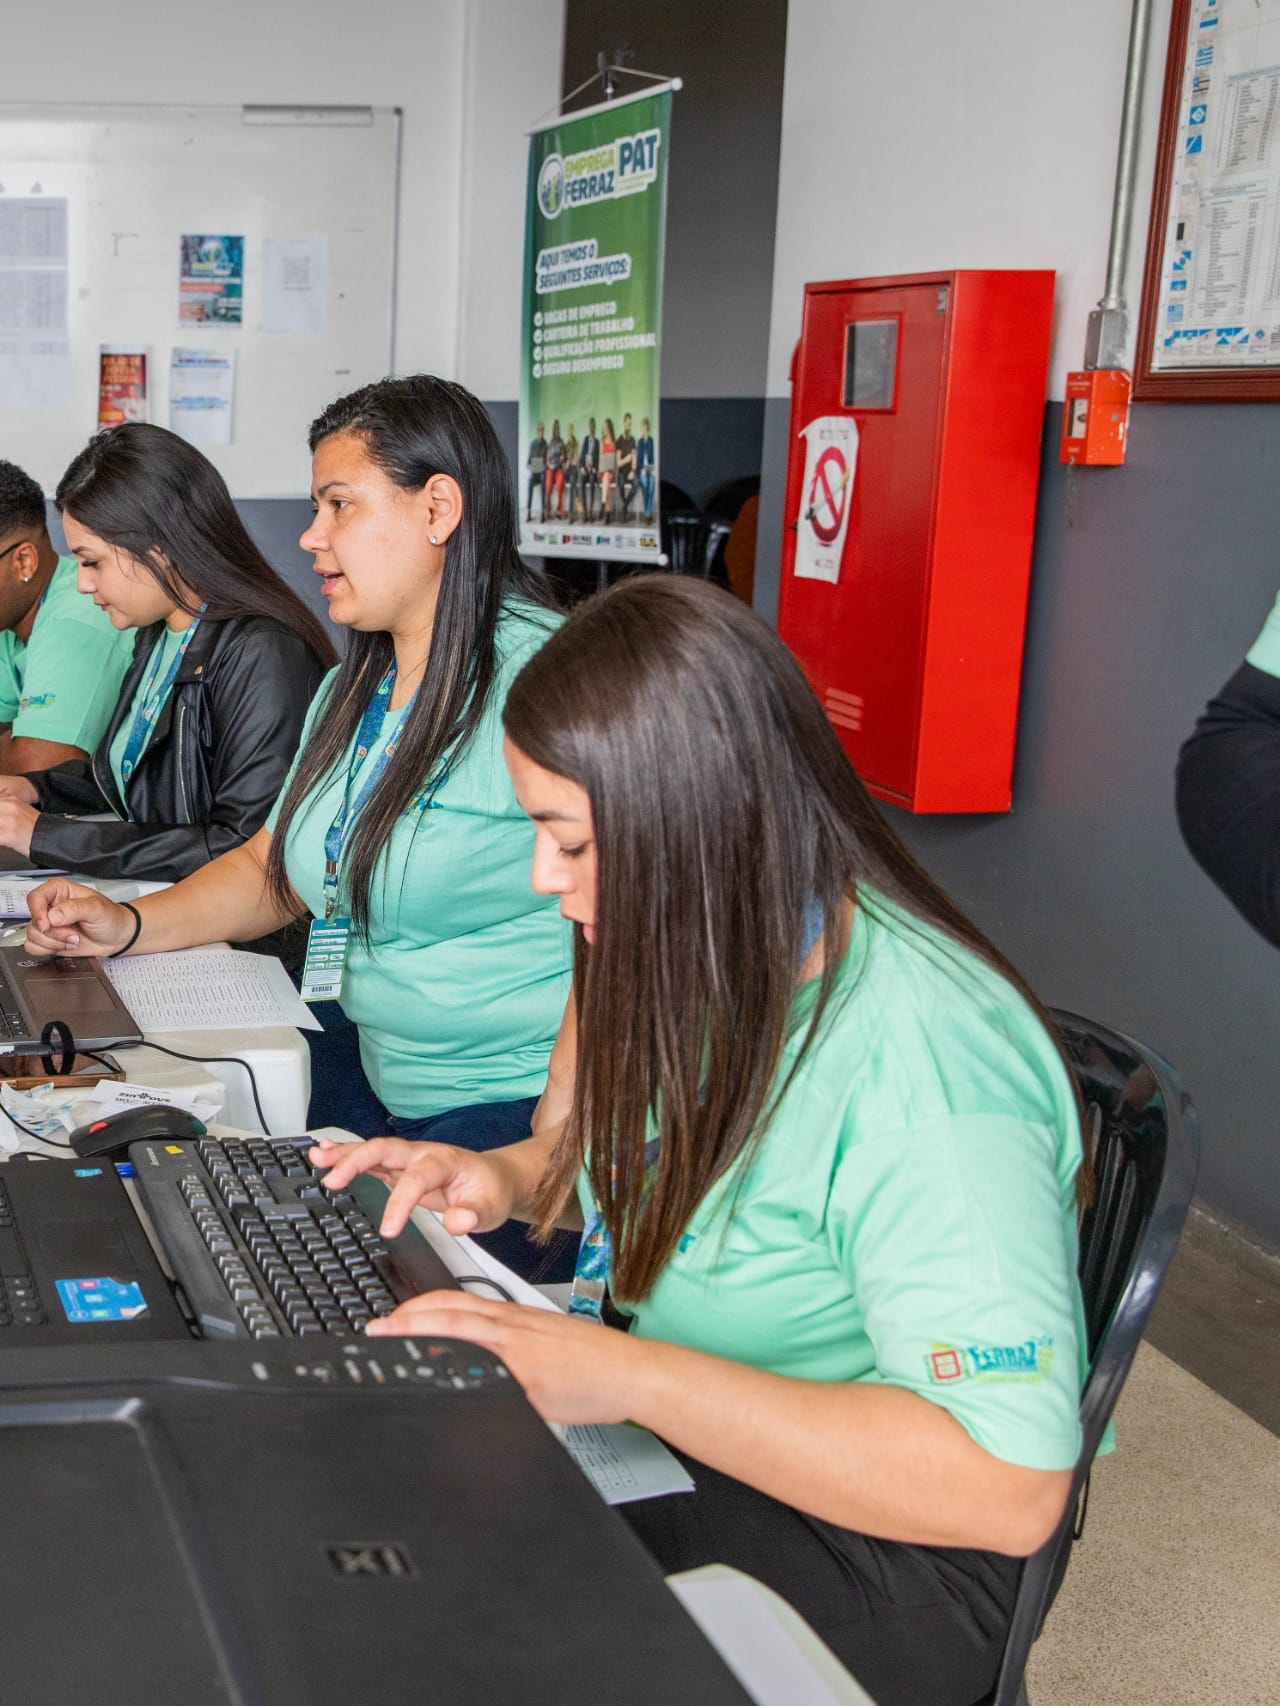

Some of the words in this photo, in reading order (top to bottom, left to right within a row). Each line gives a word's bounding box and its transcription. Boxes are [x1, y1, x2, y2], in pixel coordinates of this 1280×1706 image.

[563, 148, 615, 177] EMPREGA
[619, 134, 658, 177] PAT
[563, 169, 615, 205] FERRAZ
[540, 251, 560, 272] AQUI
[560, 244, 588, 264] TEMOS
[539, 266, 582, 289] SEGUINTES
